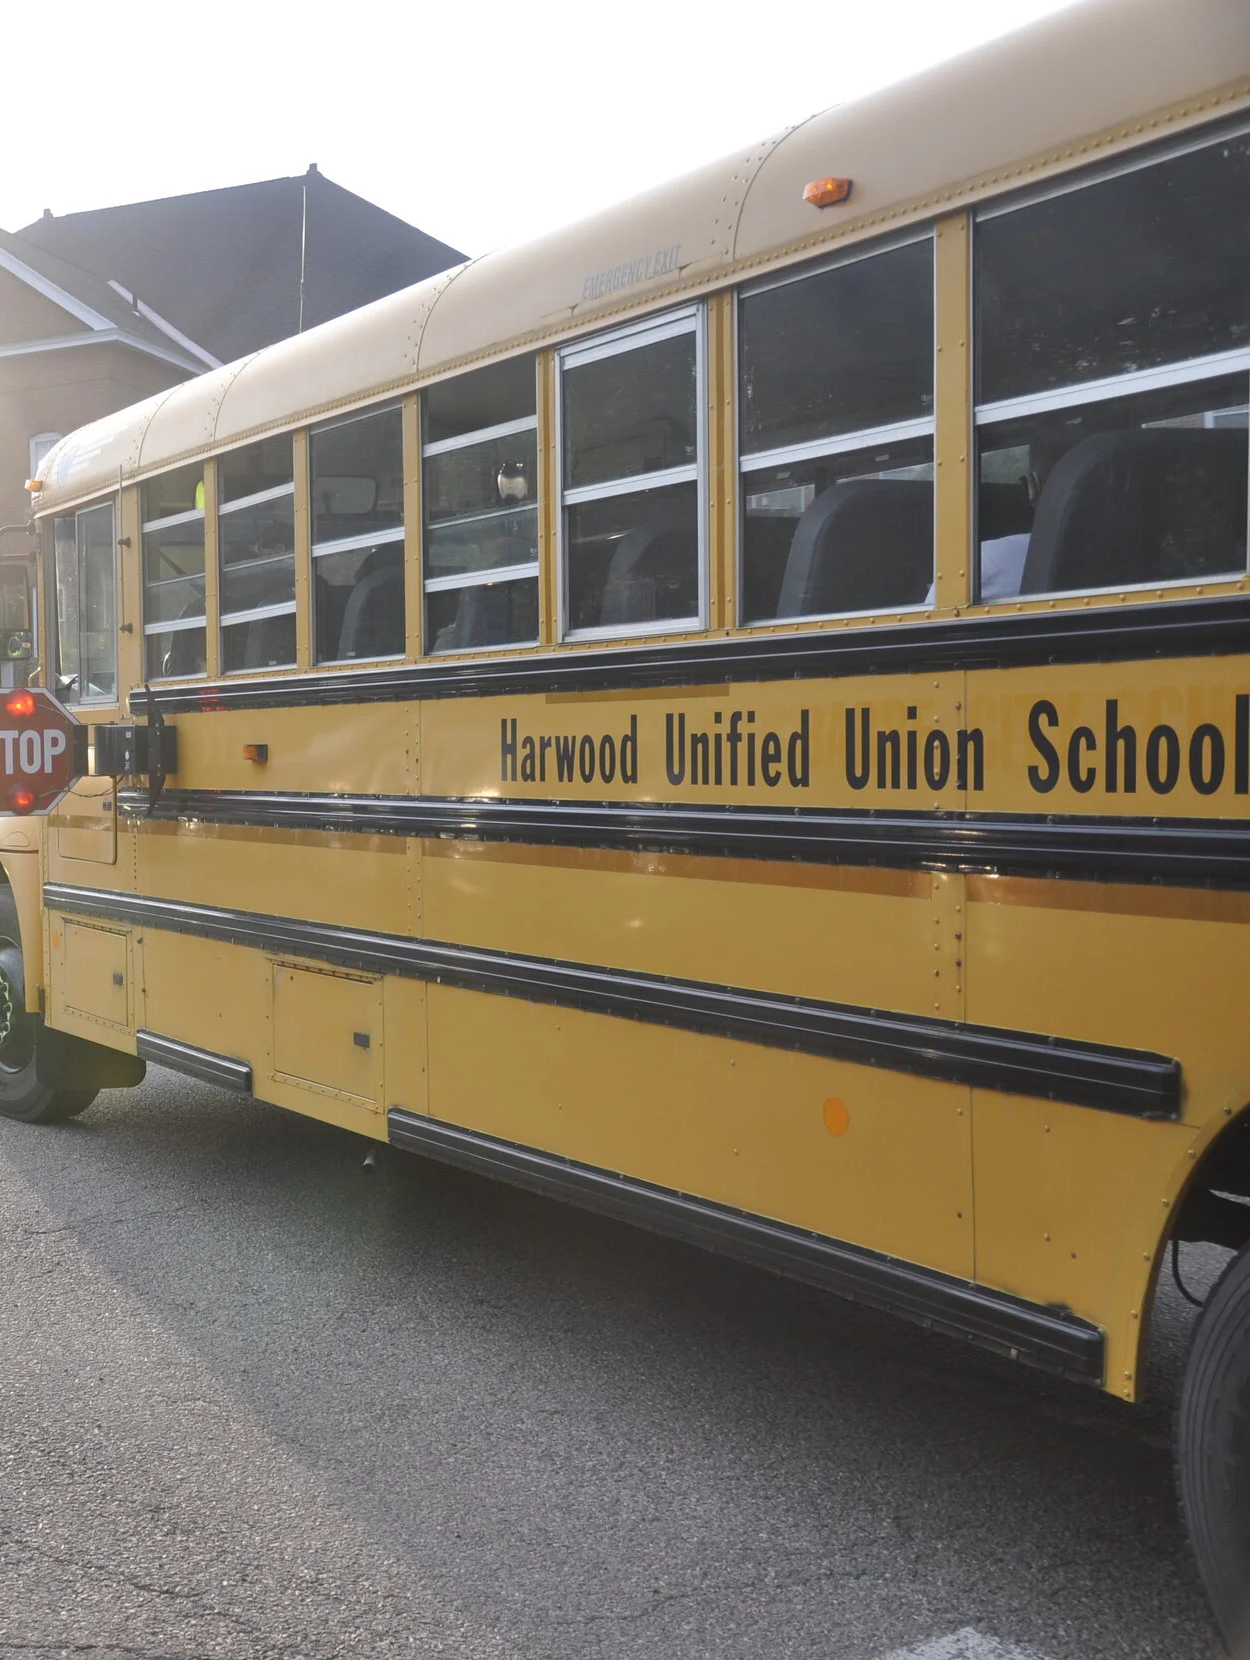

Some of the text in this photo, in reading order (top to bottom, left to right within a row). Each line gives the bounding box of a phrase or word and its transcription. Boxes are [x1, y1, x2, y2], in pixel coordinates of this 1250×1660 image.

[582, 243, 682, 300] EMERGENCY EXIT
[500, 714, 639, 785] Harwood
[664, 709, 811, 788] Unified
[845, 705, 985, 792] Union
[1027, 693, 1250, 795] School
